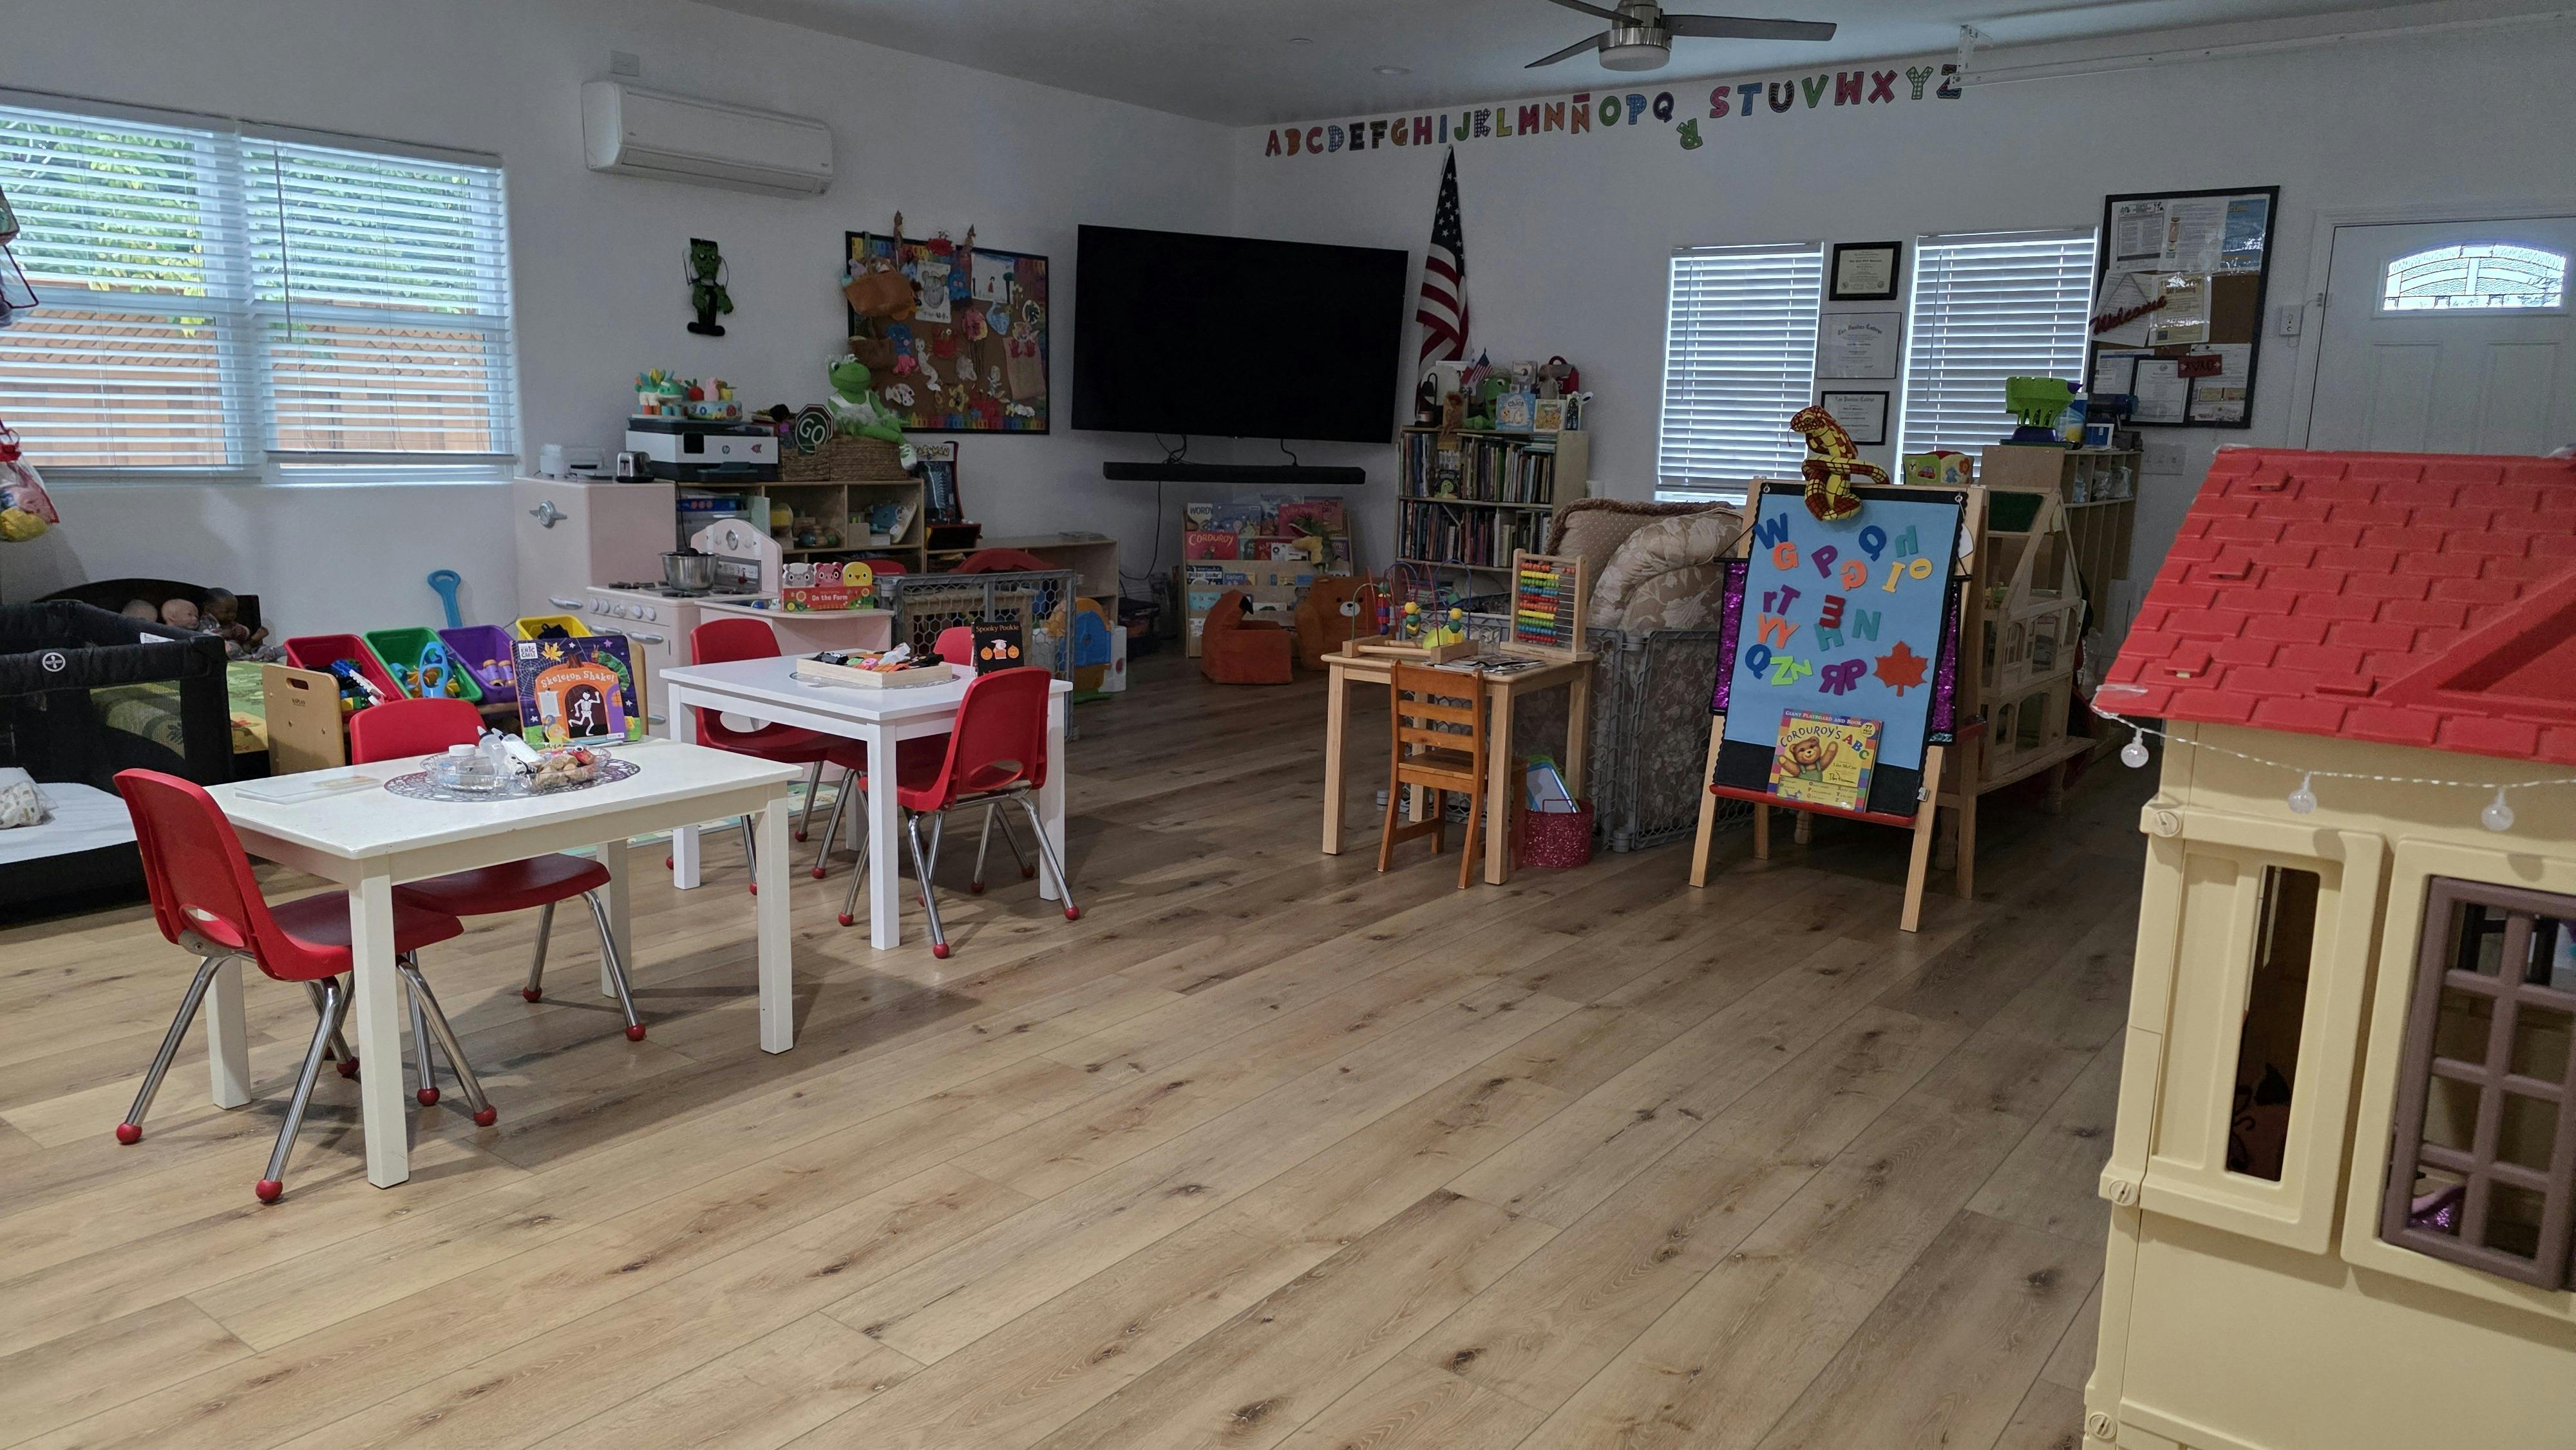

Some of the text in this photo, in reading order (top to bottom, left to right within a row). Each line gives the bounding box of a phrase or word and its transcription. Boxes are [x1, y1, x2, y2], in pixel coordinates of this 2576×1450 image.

[1265, 129, 1282, 157] A
[1285, 128, 1302, 156] B
[1305, 126, 1324, 155] C
[1328, 125, 1345, 153] D
[1349, 122, 1365, 151] E
[1370, 120, 1388, 149] F
[1390, 118, 1408, 146] G
[1413, 116, 1433, 146] H
[1438, 115, 1448, 144] I
[1454, 111, 1472, 142] J
[1474, 108, 1492, 138] K
[1497, 108, 1513, 138] L
[1518, 104, 1540, 136] M
[1544, 102, 1565, 132] N
[1598, 95, 1622, 127] O
[1625, 93, 1647, 126] P
[1652, 91, 1675, 124] Q
[1709, 86, 1731, 119] S
[1737, 82, 1763, 117] T
[1768, 80, 1795, 113] U
[1801, 74, 1830, 109] V
[1834, 71, 1864, 106] W
[1868, 70, 1898, 104] X
[1906, 66, 1934, 100] Y
[799, 417, 826, 445] GO
[1188, 533, 1234, 547] CORDUROY
[1753, 513, 1789, 550] W
[1859, 525, 1887, 561] Q
[1772, 541, 1799, 570] G
[1811, 545, 1838, 579] P
[1777, 584, 1802, 616] T
[1852, 608, 1882, 642] N
[540, 670, 615, 688] Skeleton Shake!
[1745, 643, 1772, 681] Q
[1770, 655, 1794, 686] Z
[1841, 659, 1868, 692] P
[1803, 713, 1833, 721] PLAYBOARD
[1781, 726, 1842, 747] CORDUROY'S
